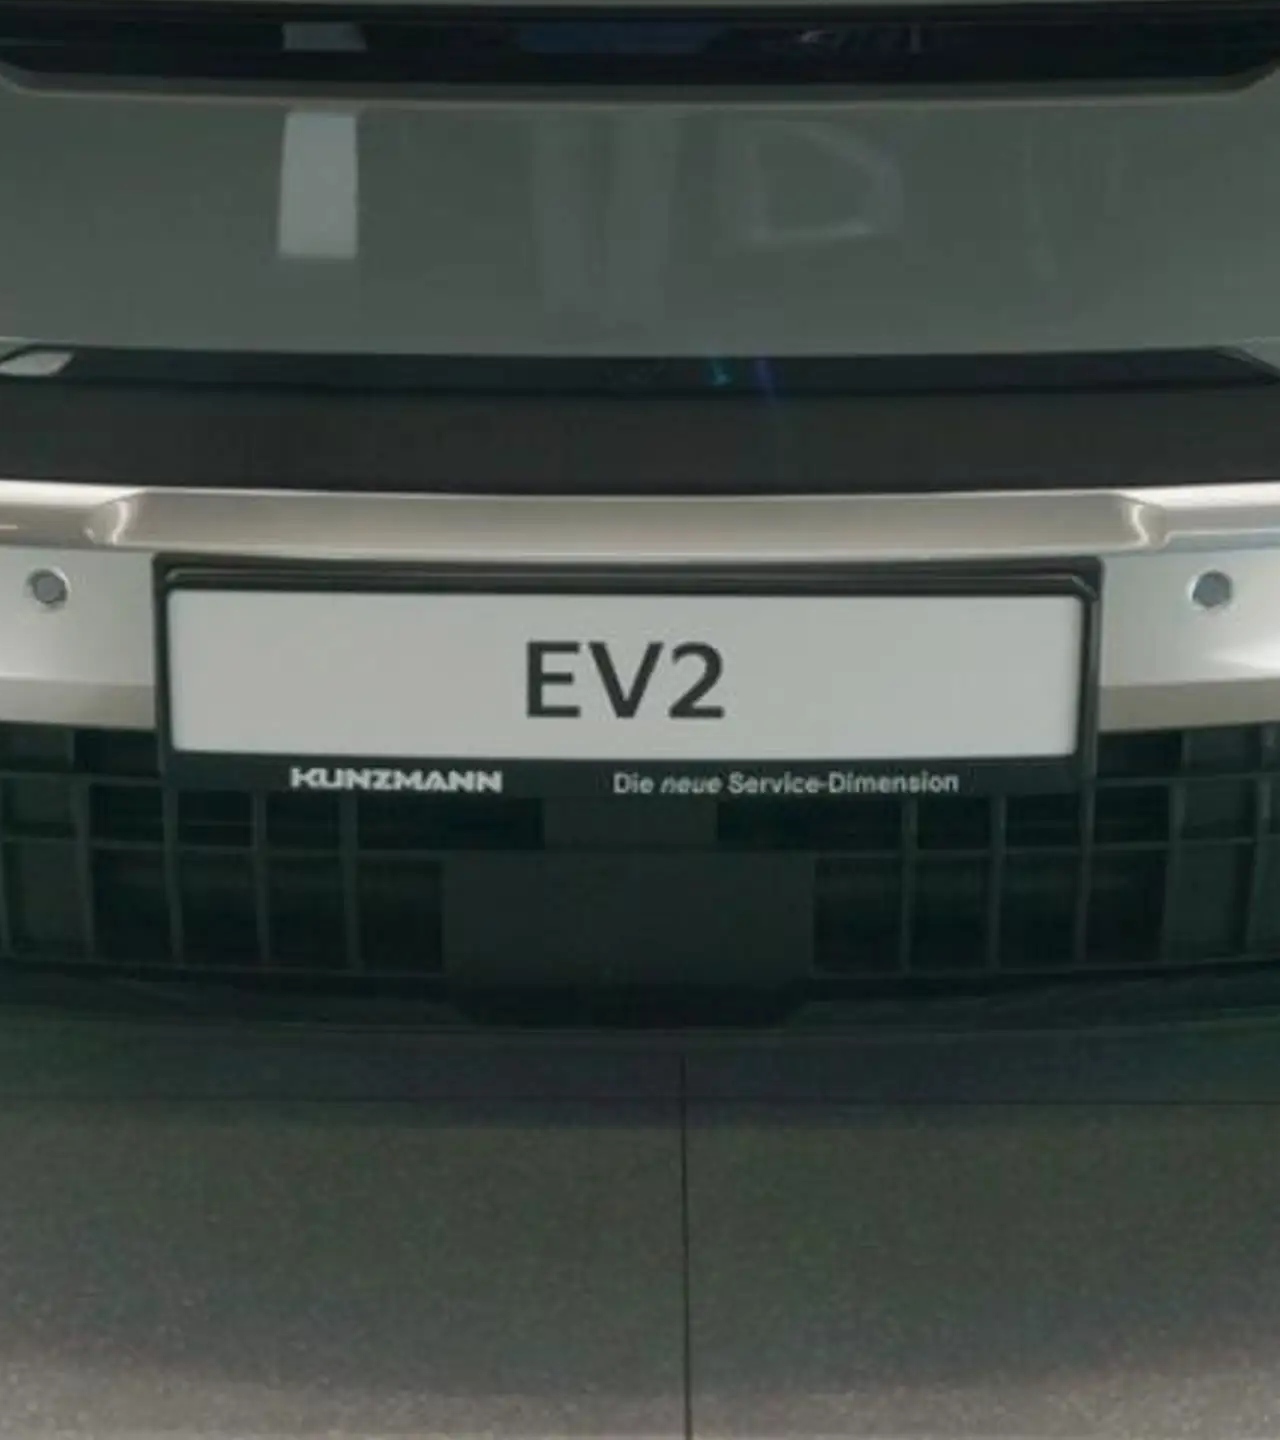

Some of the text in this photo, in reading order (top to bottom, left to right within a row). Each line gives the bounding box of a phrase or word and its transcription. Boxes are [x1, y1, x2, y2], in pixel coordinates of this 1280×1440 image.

[526, 641, 726, 719] EV2
[290, 767, 504, 794] KUNZMANN
[613, 768, 961, 796] Die neue Service-Dimension
